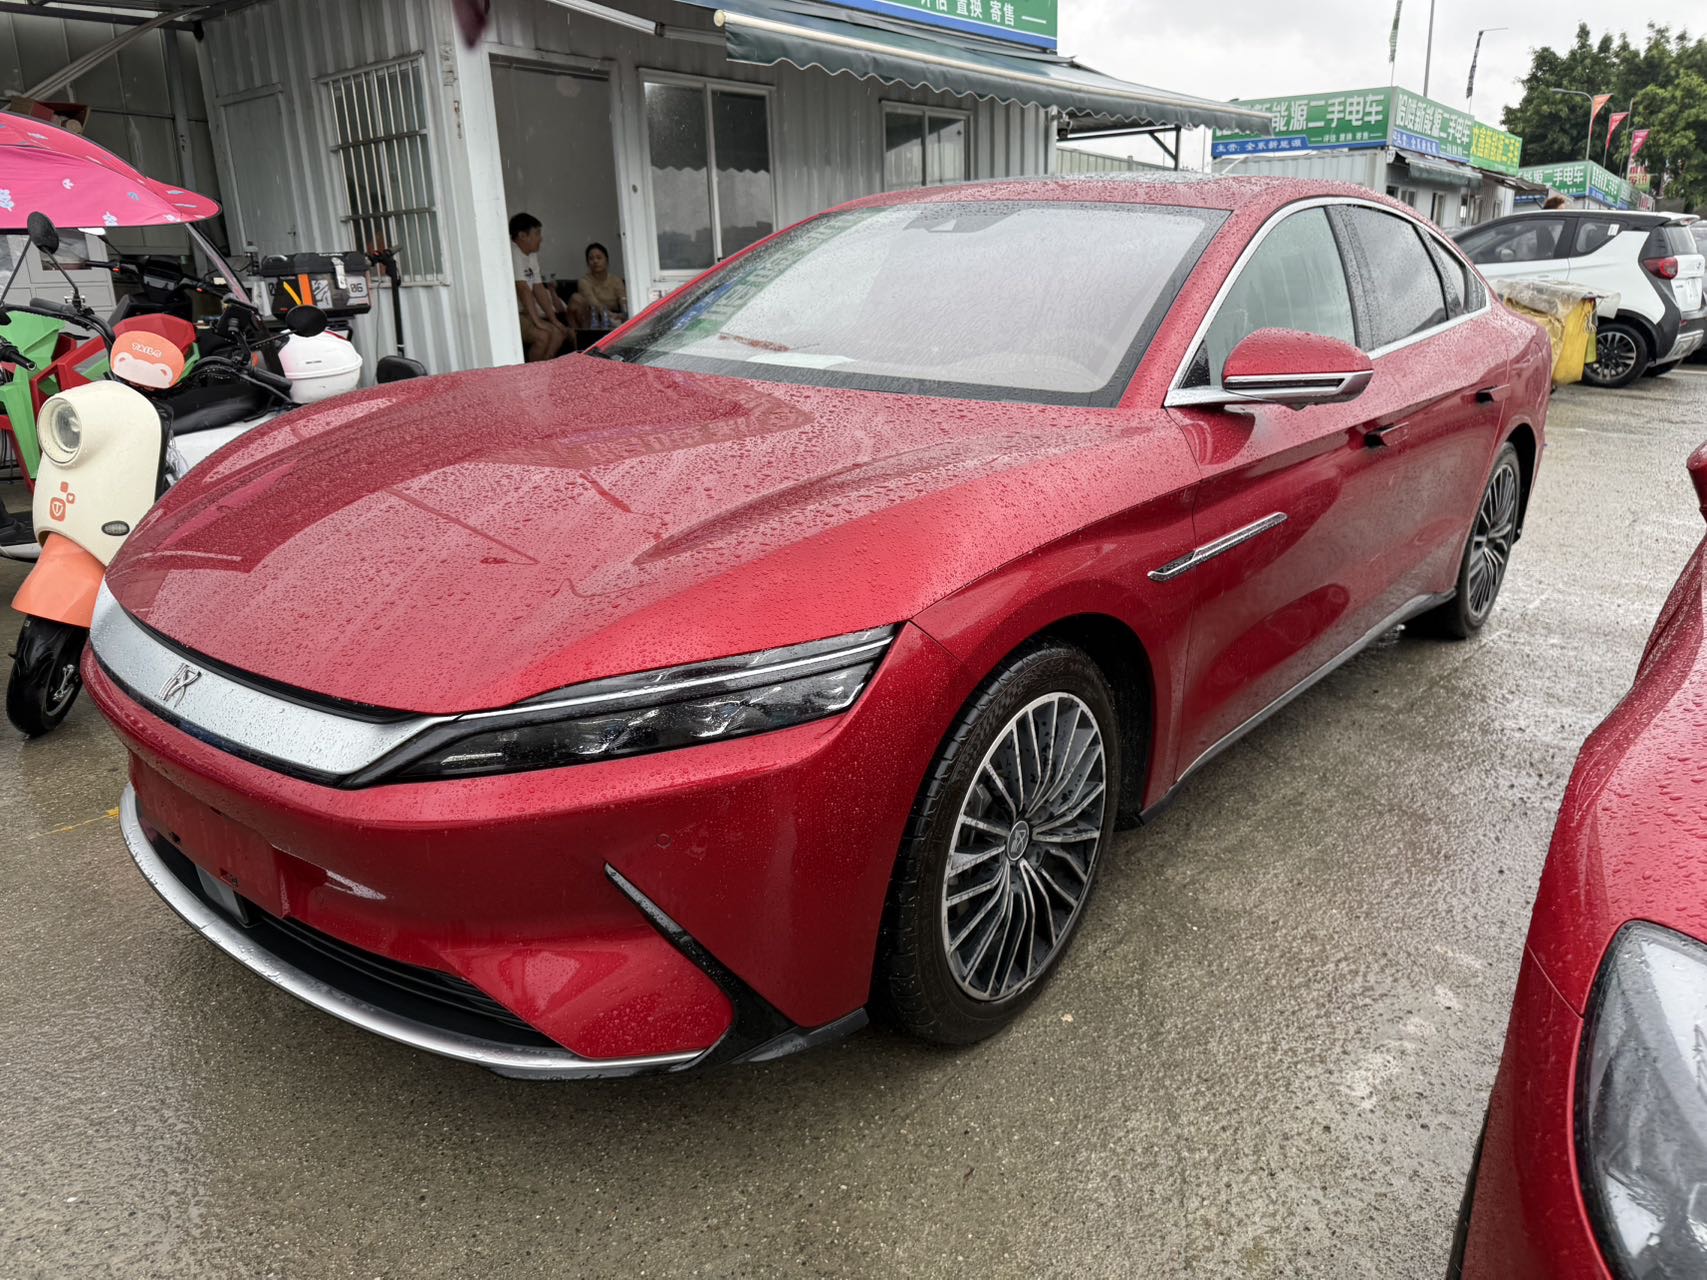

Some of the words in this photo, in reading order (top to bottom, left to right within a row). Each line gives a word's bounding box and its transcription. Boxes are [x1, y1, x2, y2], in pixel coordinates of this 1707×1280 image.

[990, 1, 1015, 26] 寄售
[1215, 94, 1385, 137] 能源二手电车
